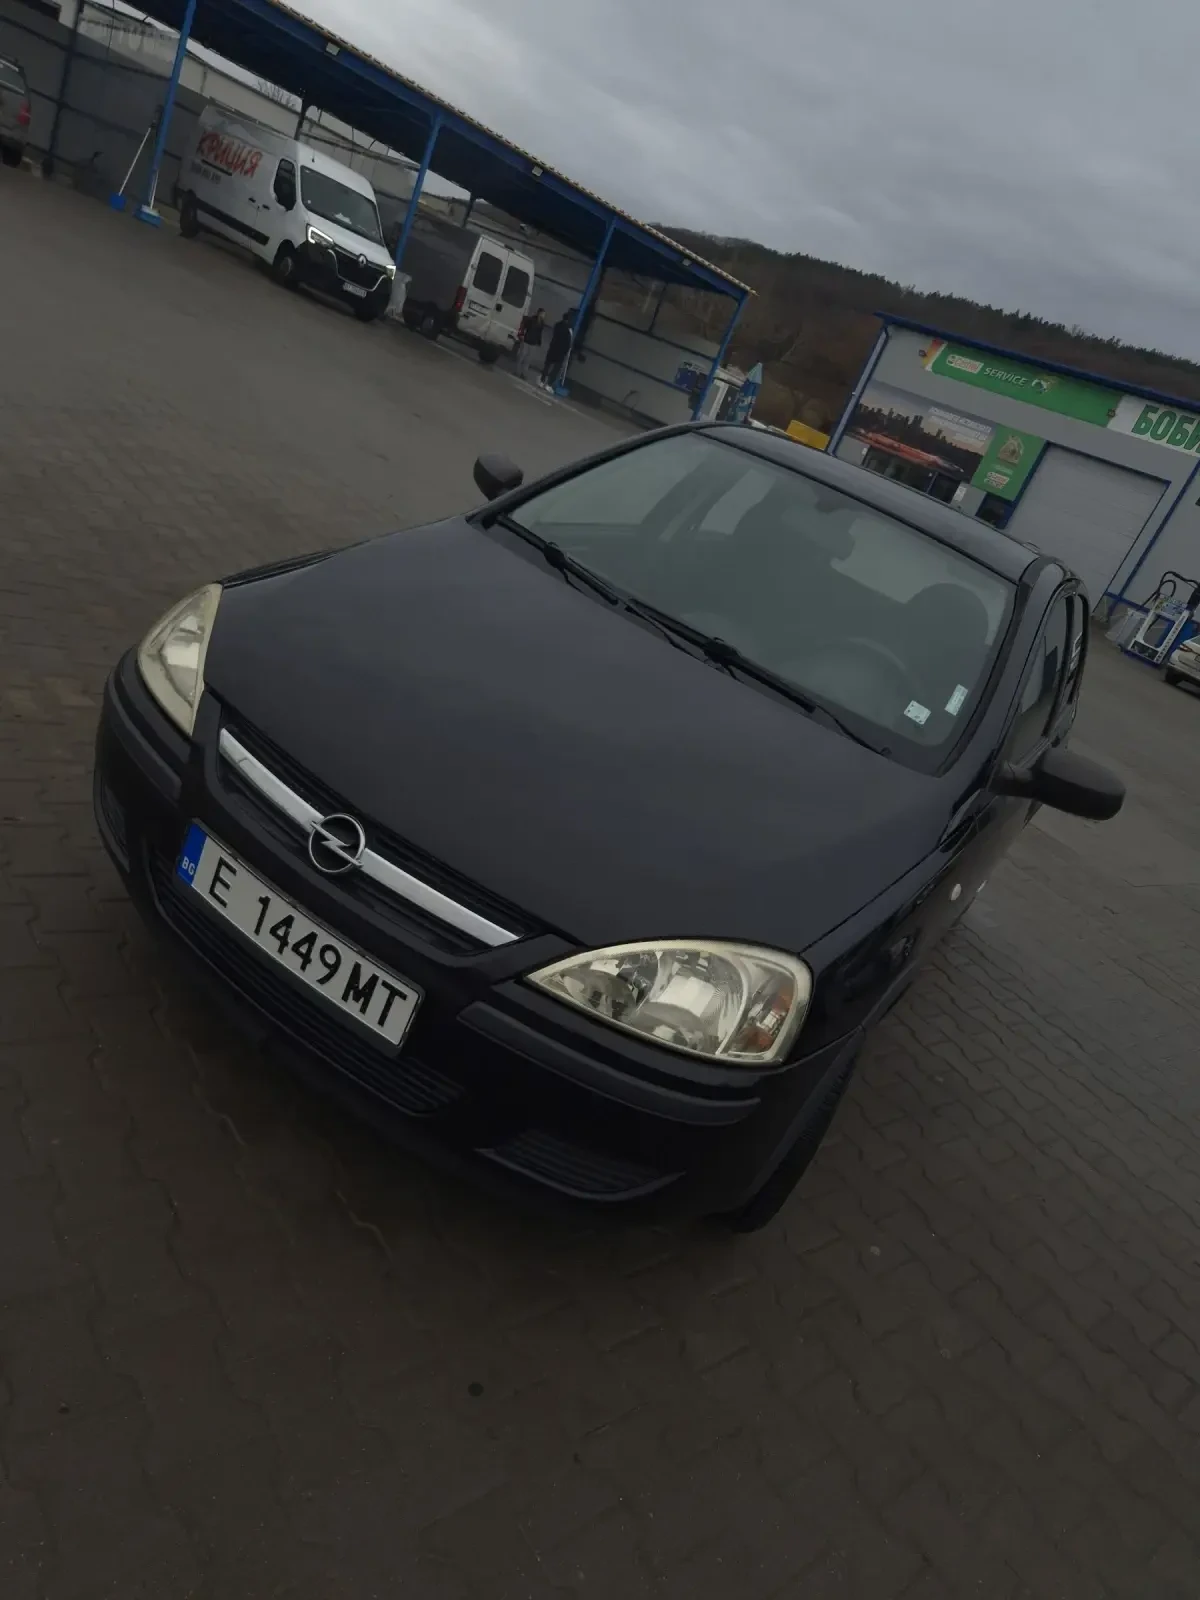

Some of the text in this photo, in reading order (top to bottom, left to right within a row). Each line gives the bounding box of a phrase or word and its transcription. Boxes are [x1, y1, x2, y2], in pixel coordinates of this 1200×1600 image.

[983, 367, 1028, 387] SERVICE
[182, 855, 196, 876] BG
[208, 855, 408, 1028] E 1449 MT
